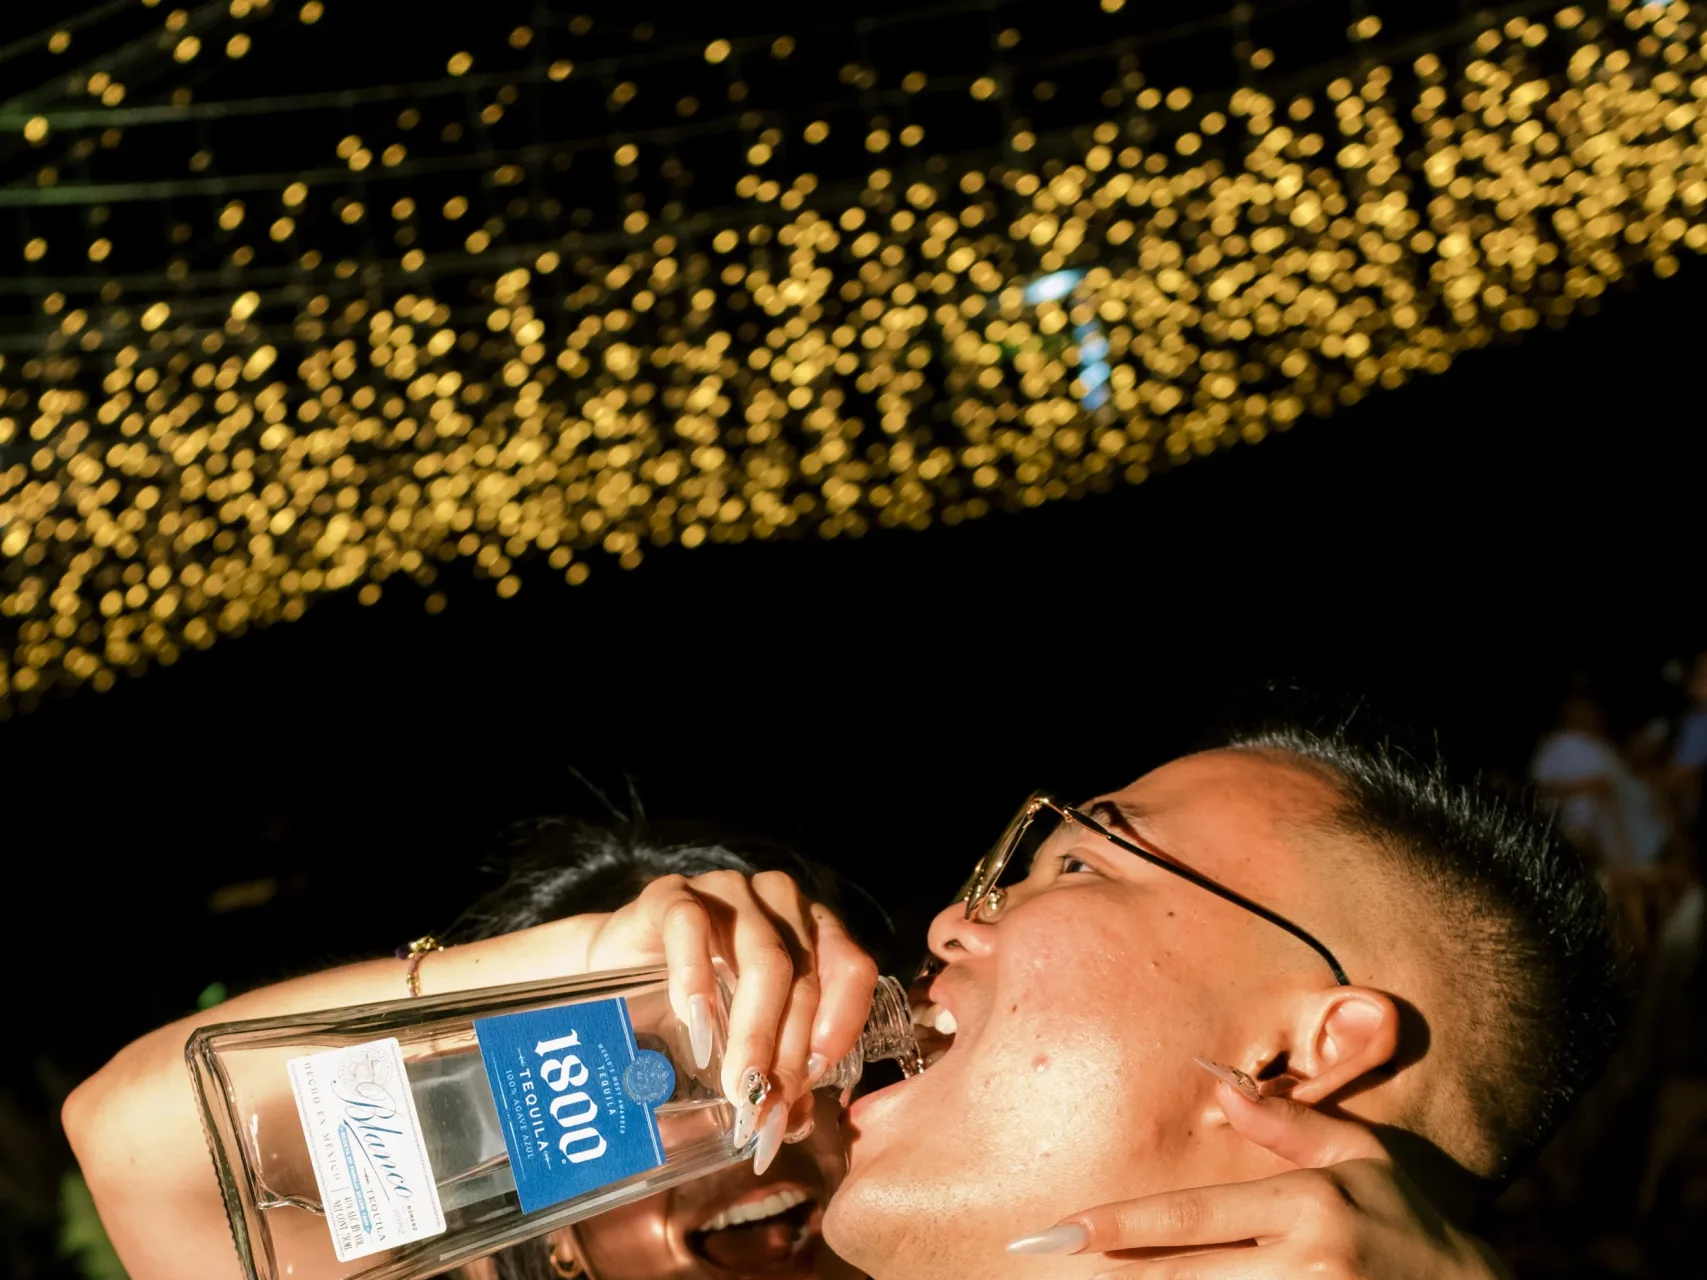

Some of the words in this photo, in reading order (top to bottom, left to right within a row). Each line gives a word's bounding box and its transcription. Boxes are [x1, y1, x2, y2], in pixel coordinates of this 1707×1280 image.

[506, 1069, 517, 1095] 100%
[512, 1098, 527, 1130] AGAVE
[521, 1133, 534, 1159] AZUL
[518, 1068, 549, 1151] TEQUILA
[534, 1028, 607, 1164] 1800
[597, 1043, 614, 1072] WORLD'S
[612, 1076, 621, 1095] MOST
[617, 1099, 626, 1134] AWARDED
[598, 1065, 615, 1115] TEQUILA
[331, 1079, 412, 1199] Blanco
[366, 1188, 386, 1241] TEQUILA
